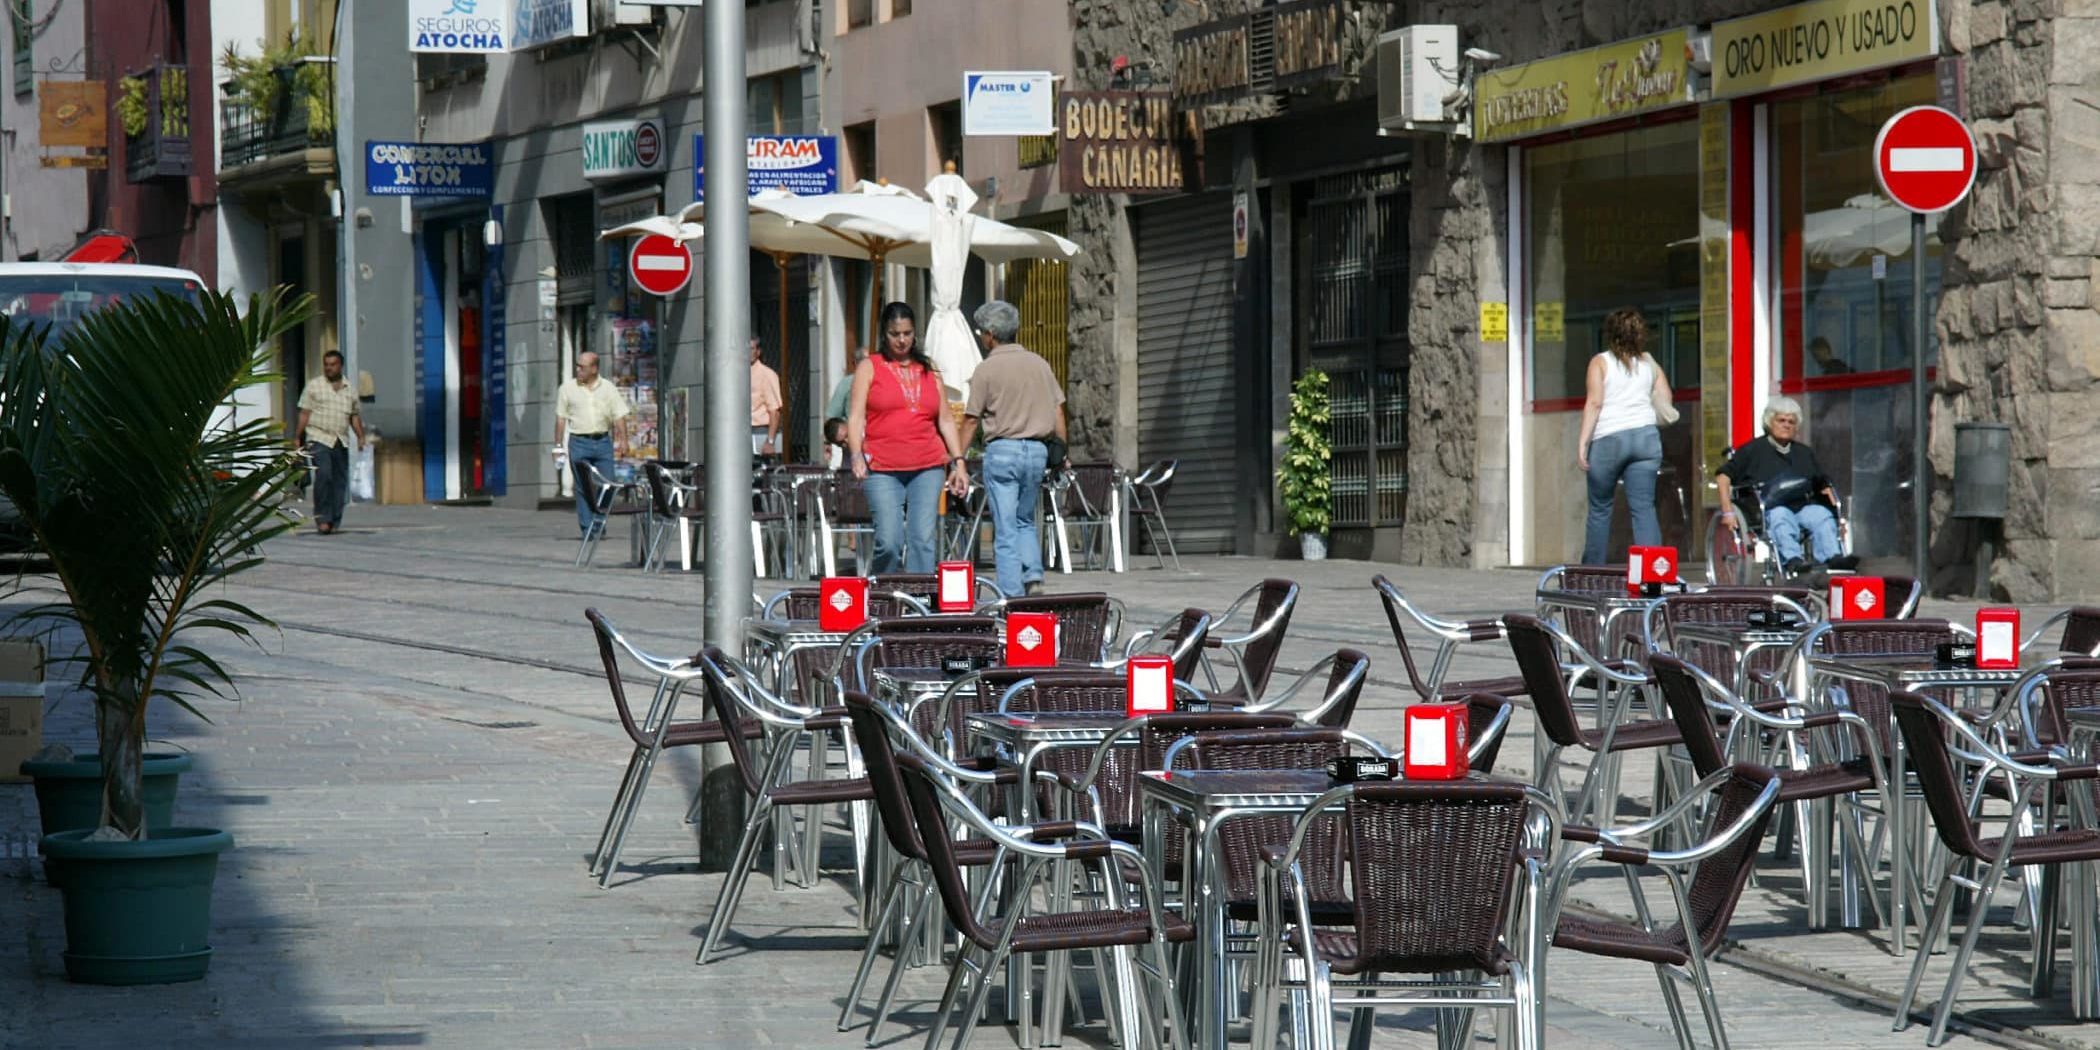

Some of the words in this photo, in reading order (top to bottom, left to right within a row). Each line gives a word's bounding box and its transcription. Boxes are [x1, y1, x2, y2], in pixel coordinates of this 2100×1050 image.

[416, 33, 503, 49] ATOCHA
[417, 17, 502, 33] SEGUROS
[531, 2, 573, 41] ATOCHA
[1725, 33, 1765, 78] ORO
[1771, 20, 1830, 69] NUEVO
[1835, 15, 1847, 55] Y
[1852, 1, 1916, 52] USADO
[980, 83, 1016, 92] MASTER
[584, 129, 635, 171] SANTOS
[1082, 144, 1184, 188] CANARIA
